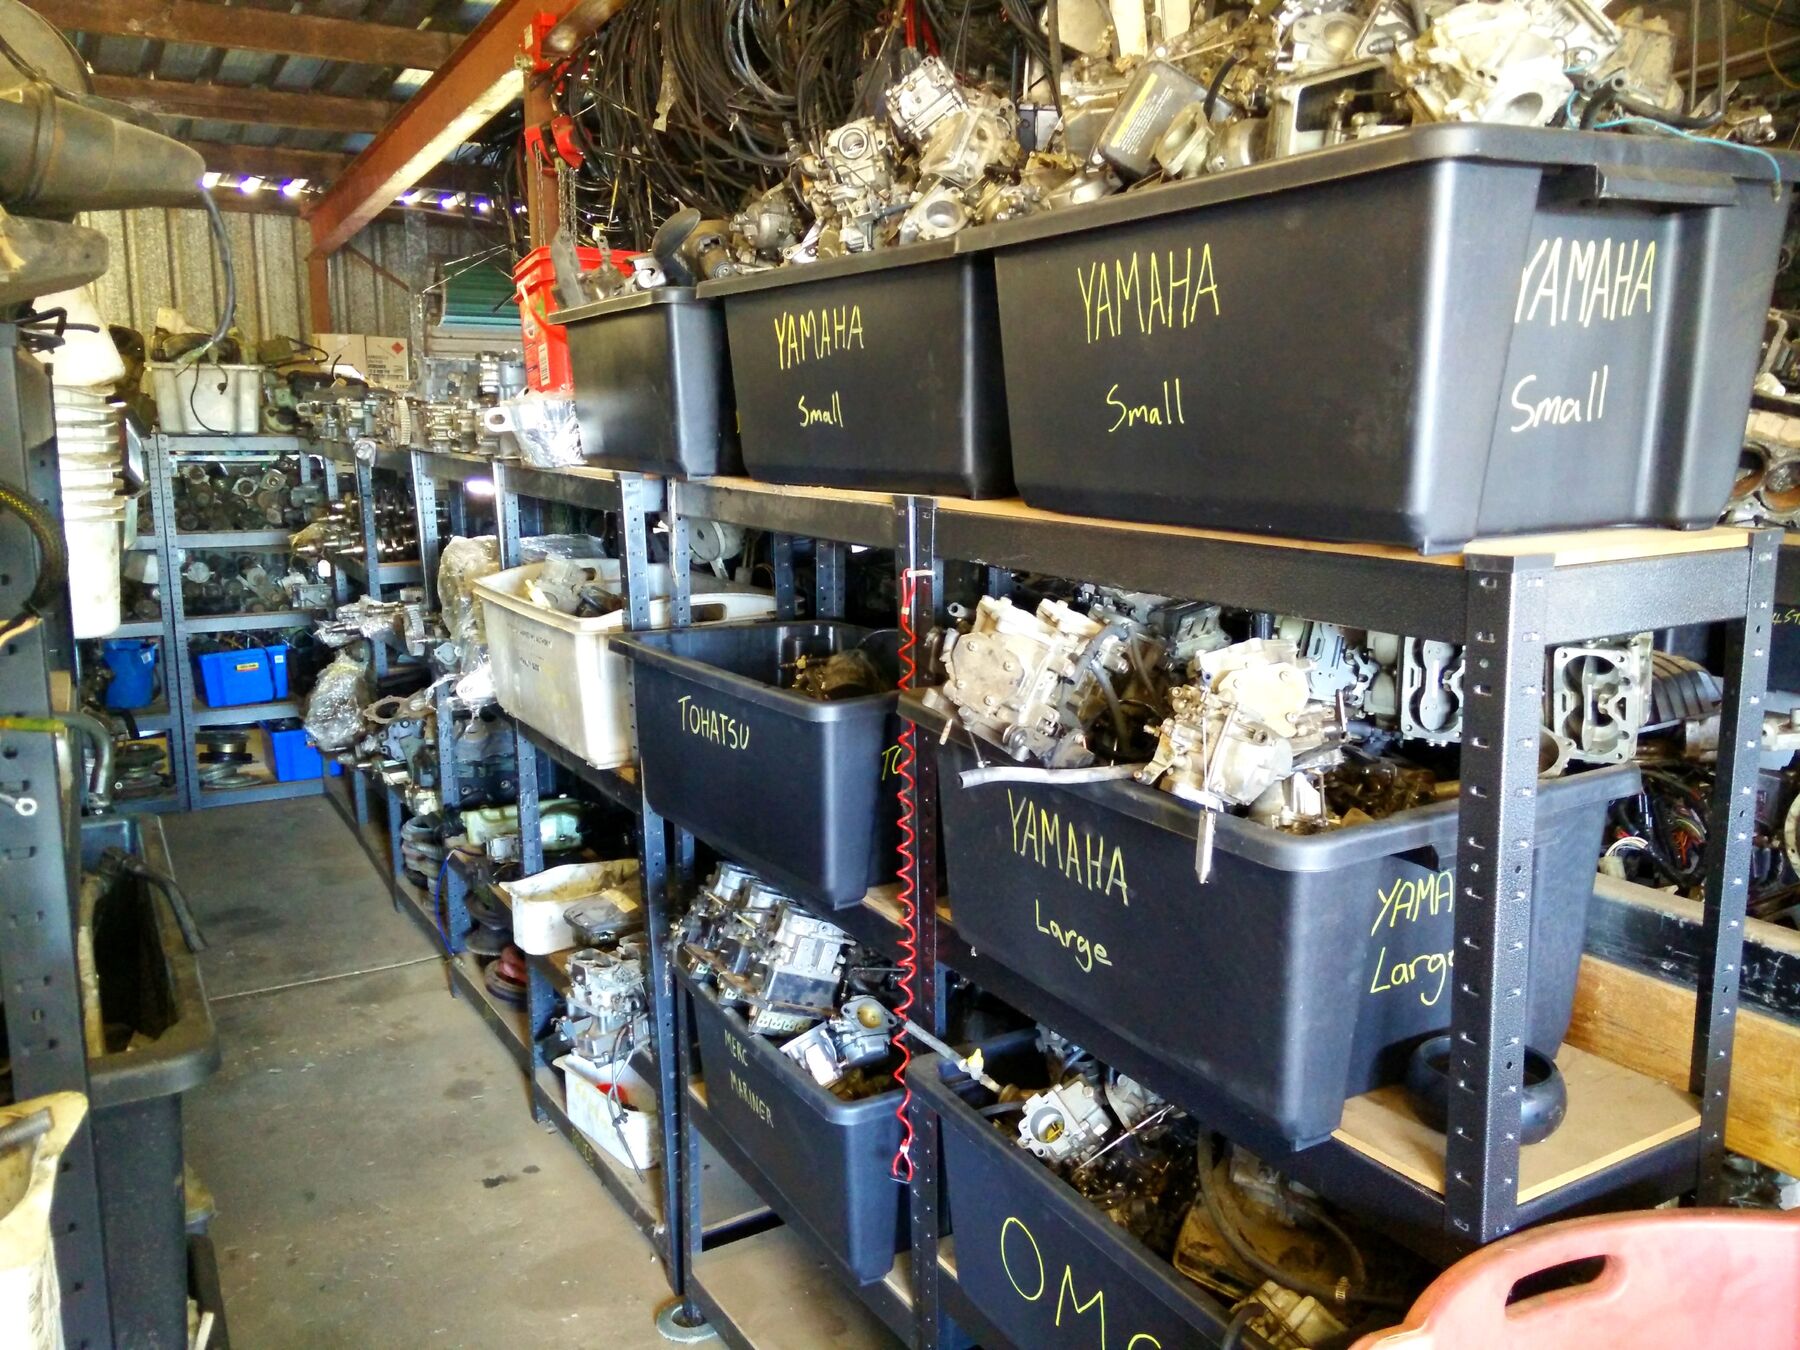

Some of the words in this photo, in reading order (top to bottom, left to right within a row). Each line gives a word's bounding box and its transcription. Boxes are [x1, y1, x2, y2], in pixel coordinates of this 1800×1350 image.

[1077, 243, 1220, 344] YAMAHA
[1514, 236, 1656, 328] YAMAHA
[773, 304, 865, 371] YAMAHA
[797, 390, 844, 428] Small
[1106, 377, 1185, 433] Small
[1510, 364, 1609, 433] Small
[677, 694, 750, 751] TOHATSU
[1007, 788, 1130, 907] YAMAHA
[1035, 898, 1113, 974] Large
[724, 1029, 748, 1067] MERC
[730, 1069, 774, 1129] MARINER
